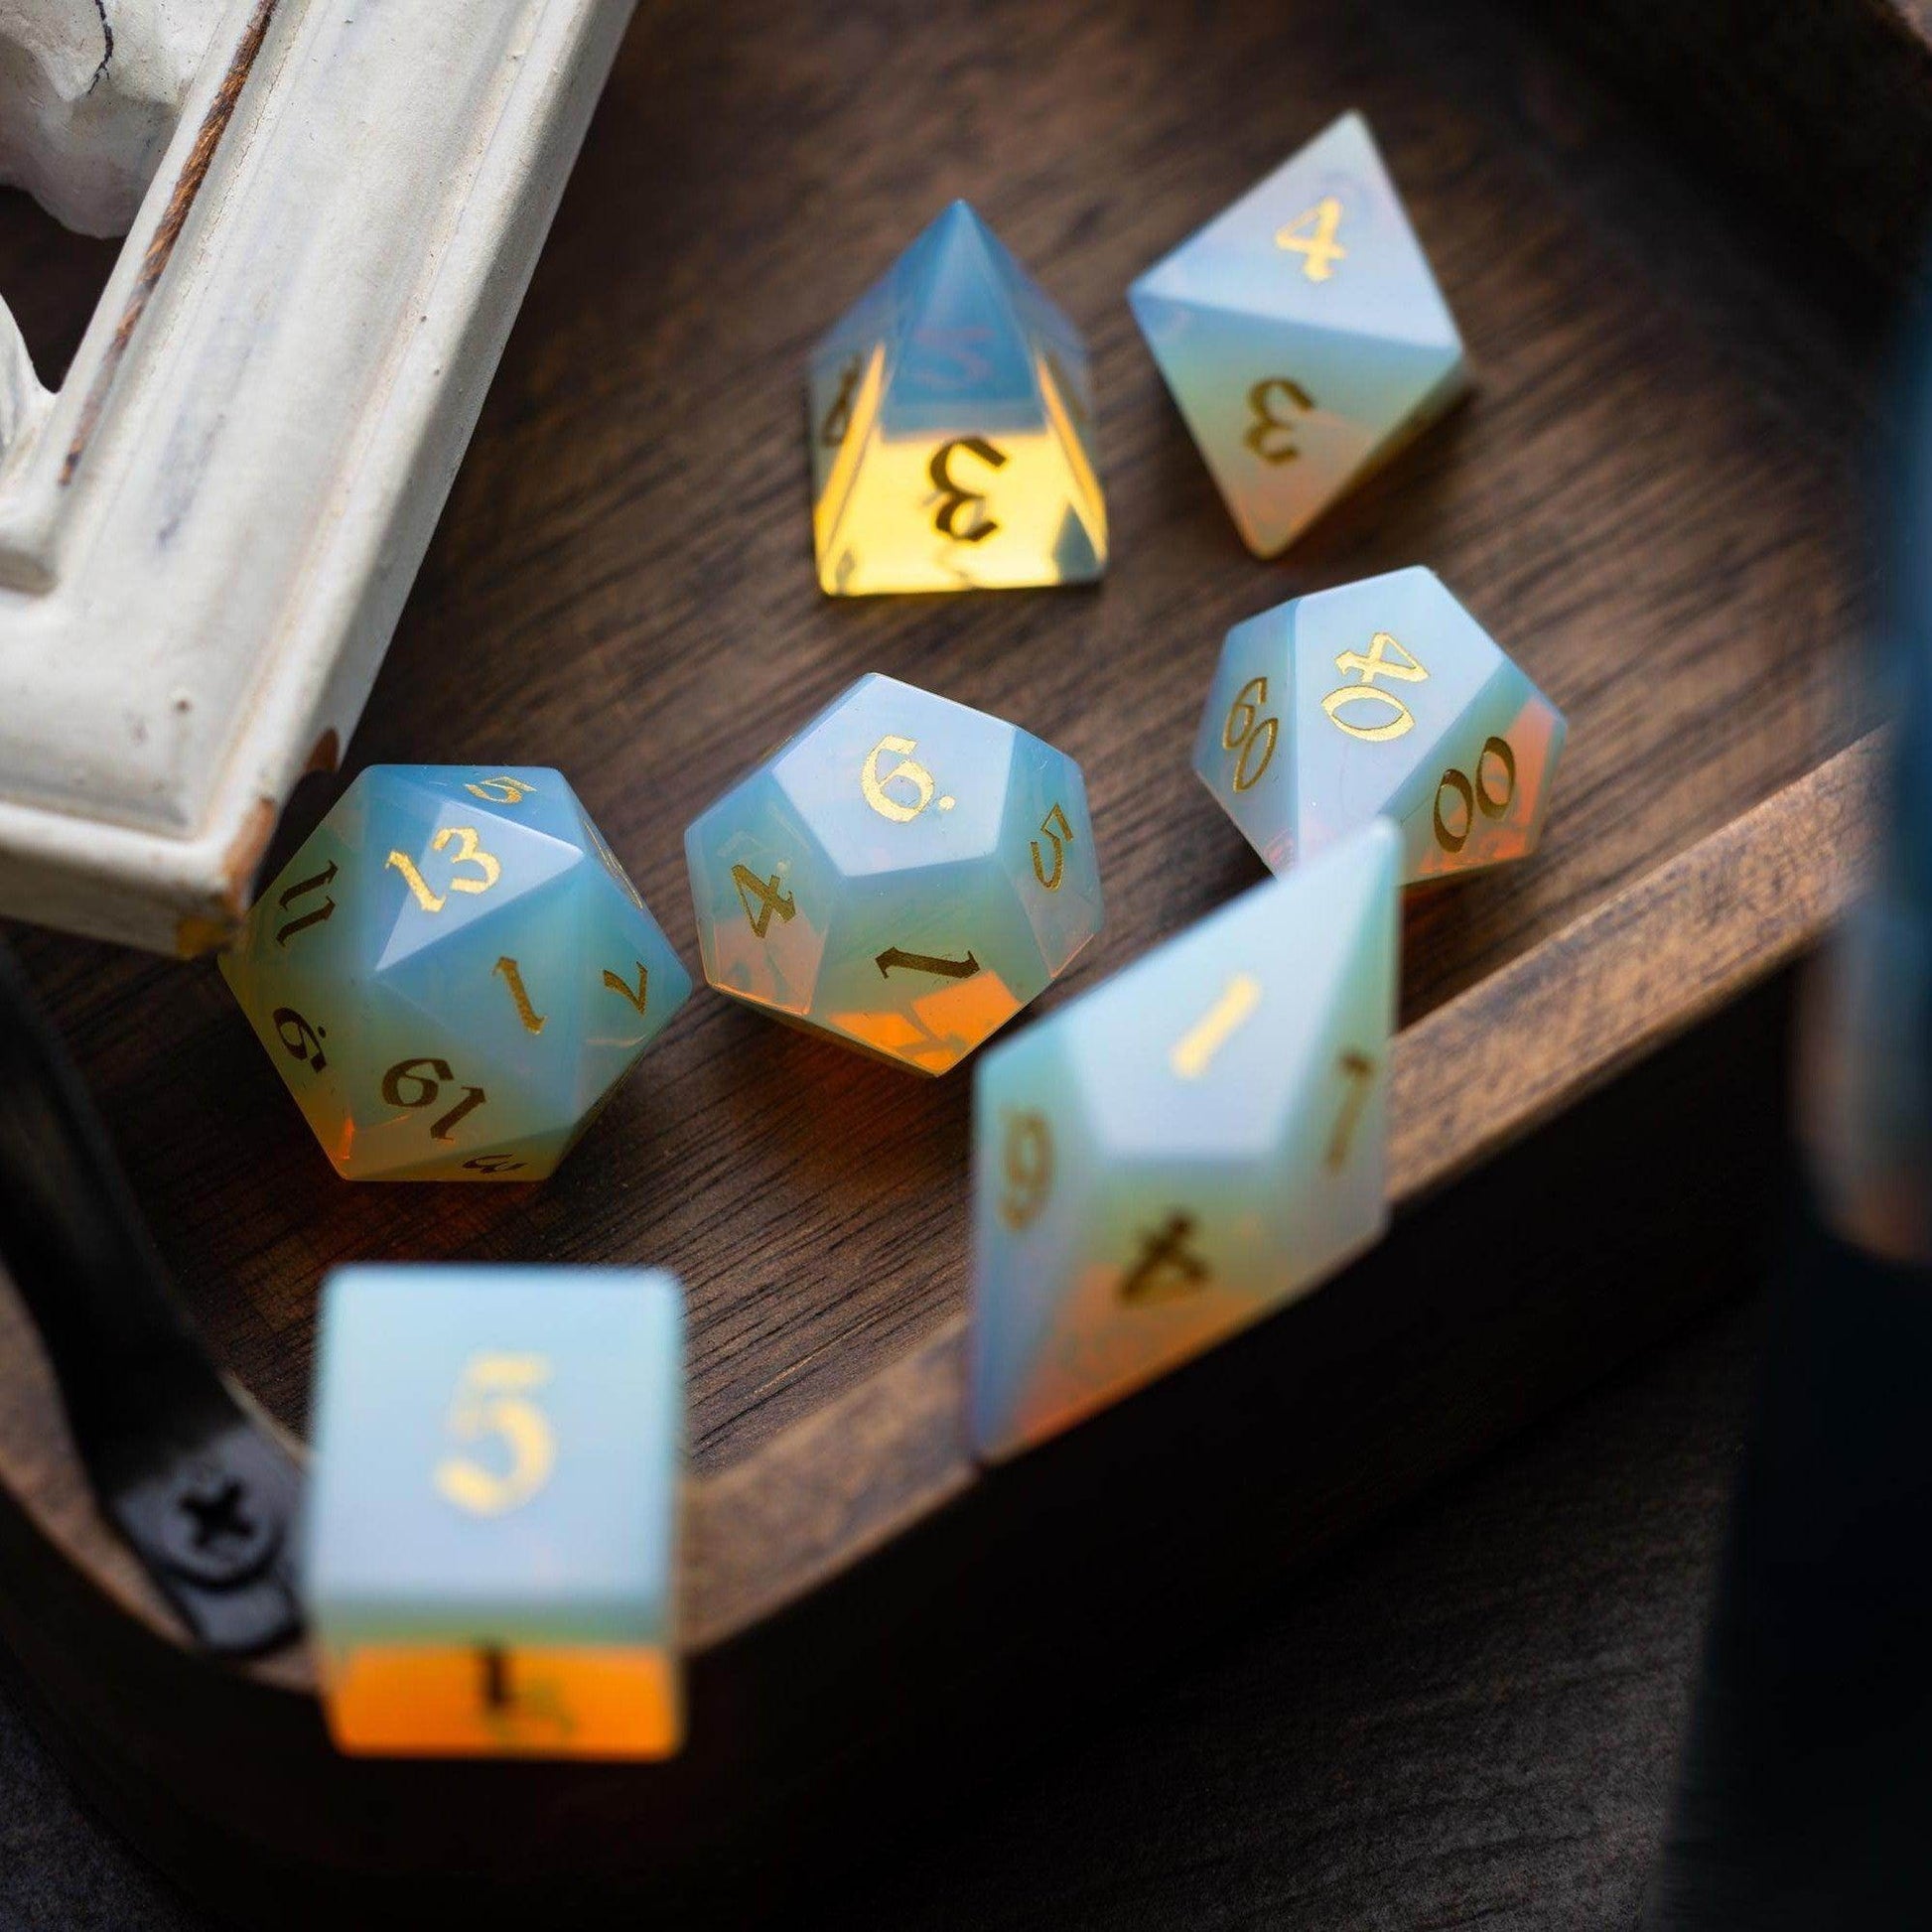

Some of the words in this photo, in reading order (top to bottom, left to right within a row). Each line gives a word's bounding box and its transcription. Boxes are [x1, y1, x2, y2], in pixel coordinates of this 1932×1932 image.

[1276, 196, 1347, 282] 4
[1245, 376, 1315, 465] 3
[928, 435, 1008, 543] 3
[1320, 631, 1430, 742] 40
[1433, 736, 1516, 854] 00
[384, 826, 501, 912] 13
[1029, 802, 1073, 891] 5
[276, 860, 340, 947] 11
[731, 864, 796, 938] 4
[491, 955, 548, 1035] 1
[875, 946, 981, 980] 1
[1172, 975, 1259, 1078] 1
[433, 1352, 556, 1516] 5
